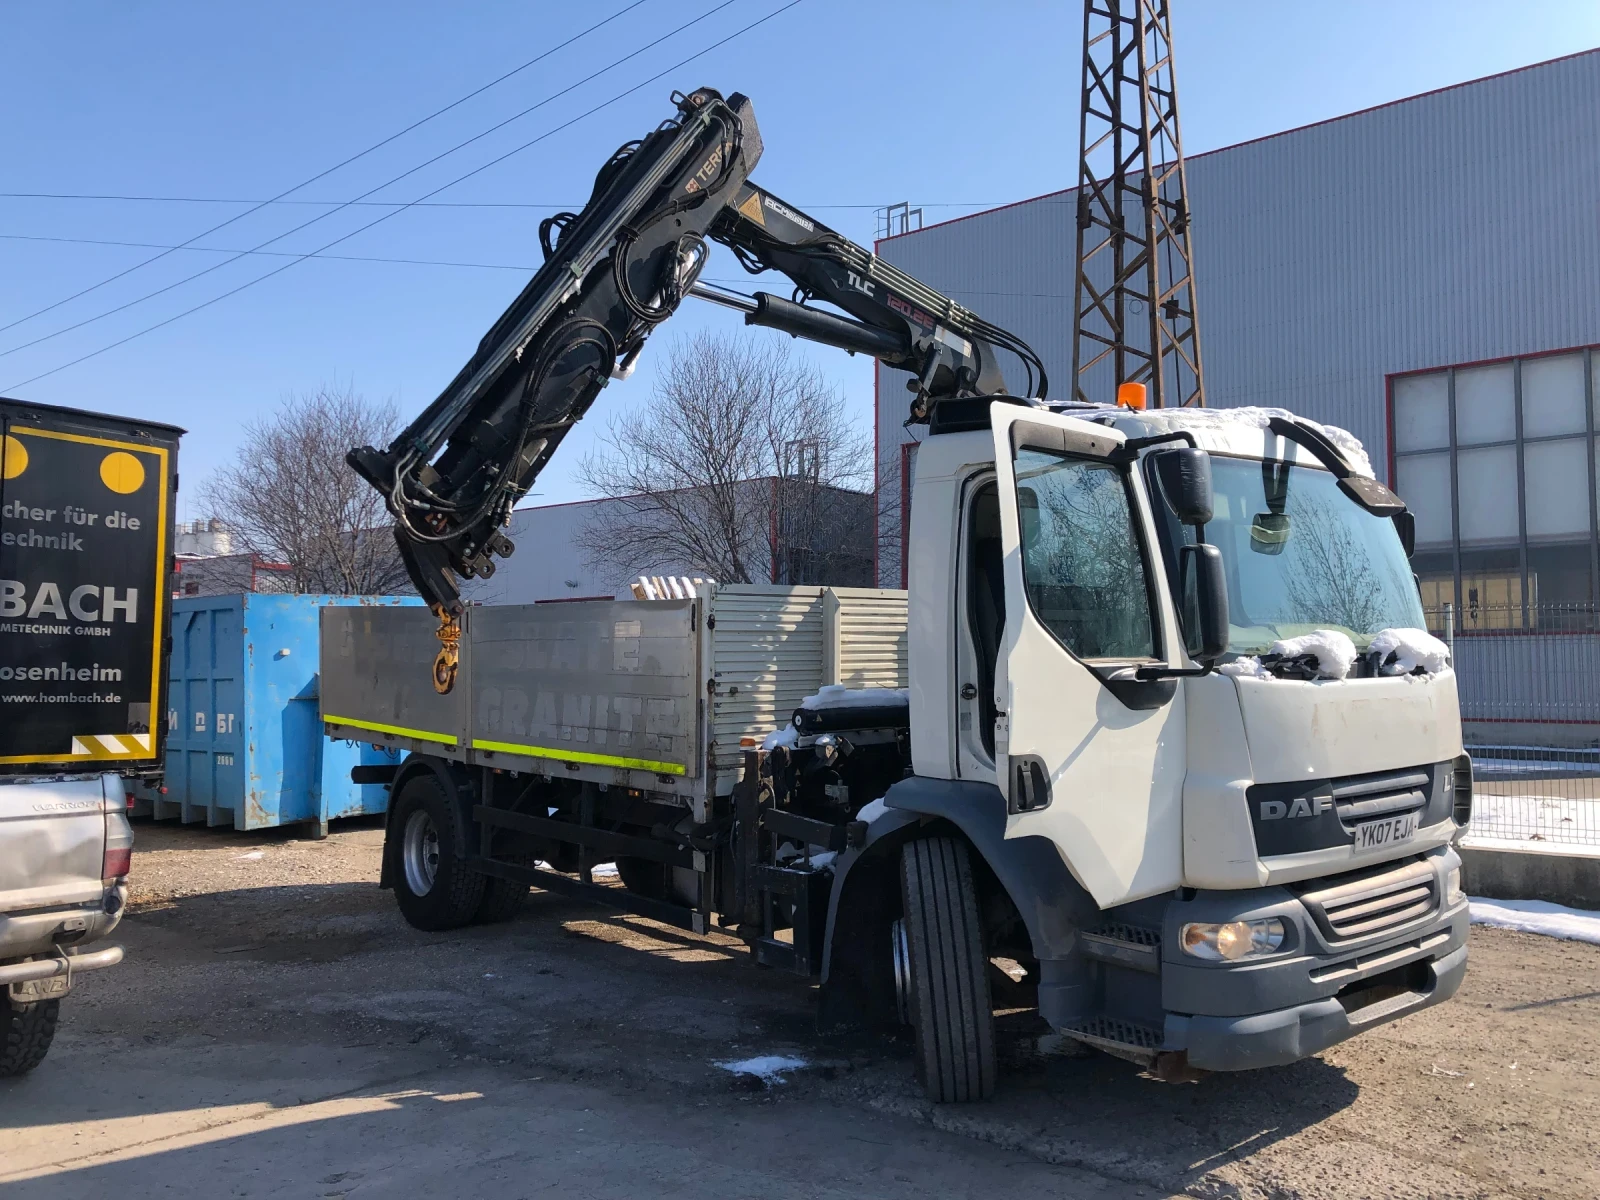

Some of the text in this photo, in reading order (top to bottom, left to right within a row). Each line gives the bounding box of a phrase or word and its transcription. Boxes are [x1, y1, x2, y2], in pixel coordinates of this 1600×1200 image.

[847, 270, 876, 297] TLC
[886, 292, 937, 331] 120.2E
[2, 500, 141, 531] cher für die
[1, 529, 84, 551] echnik
[0, 579, 138, 623] BACH
[74, 626, 111, 637] GMBH
[0, 661, 122, 682] osenheim
[1, 692, 122, 703] www.hombach.de
[1260, 795, 1333, 821] DAF
[1361, 817, 1414, 847] YK07 EJA
